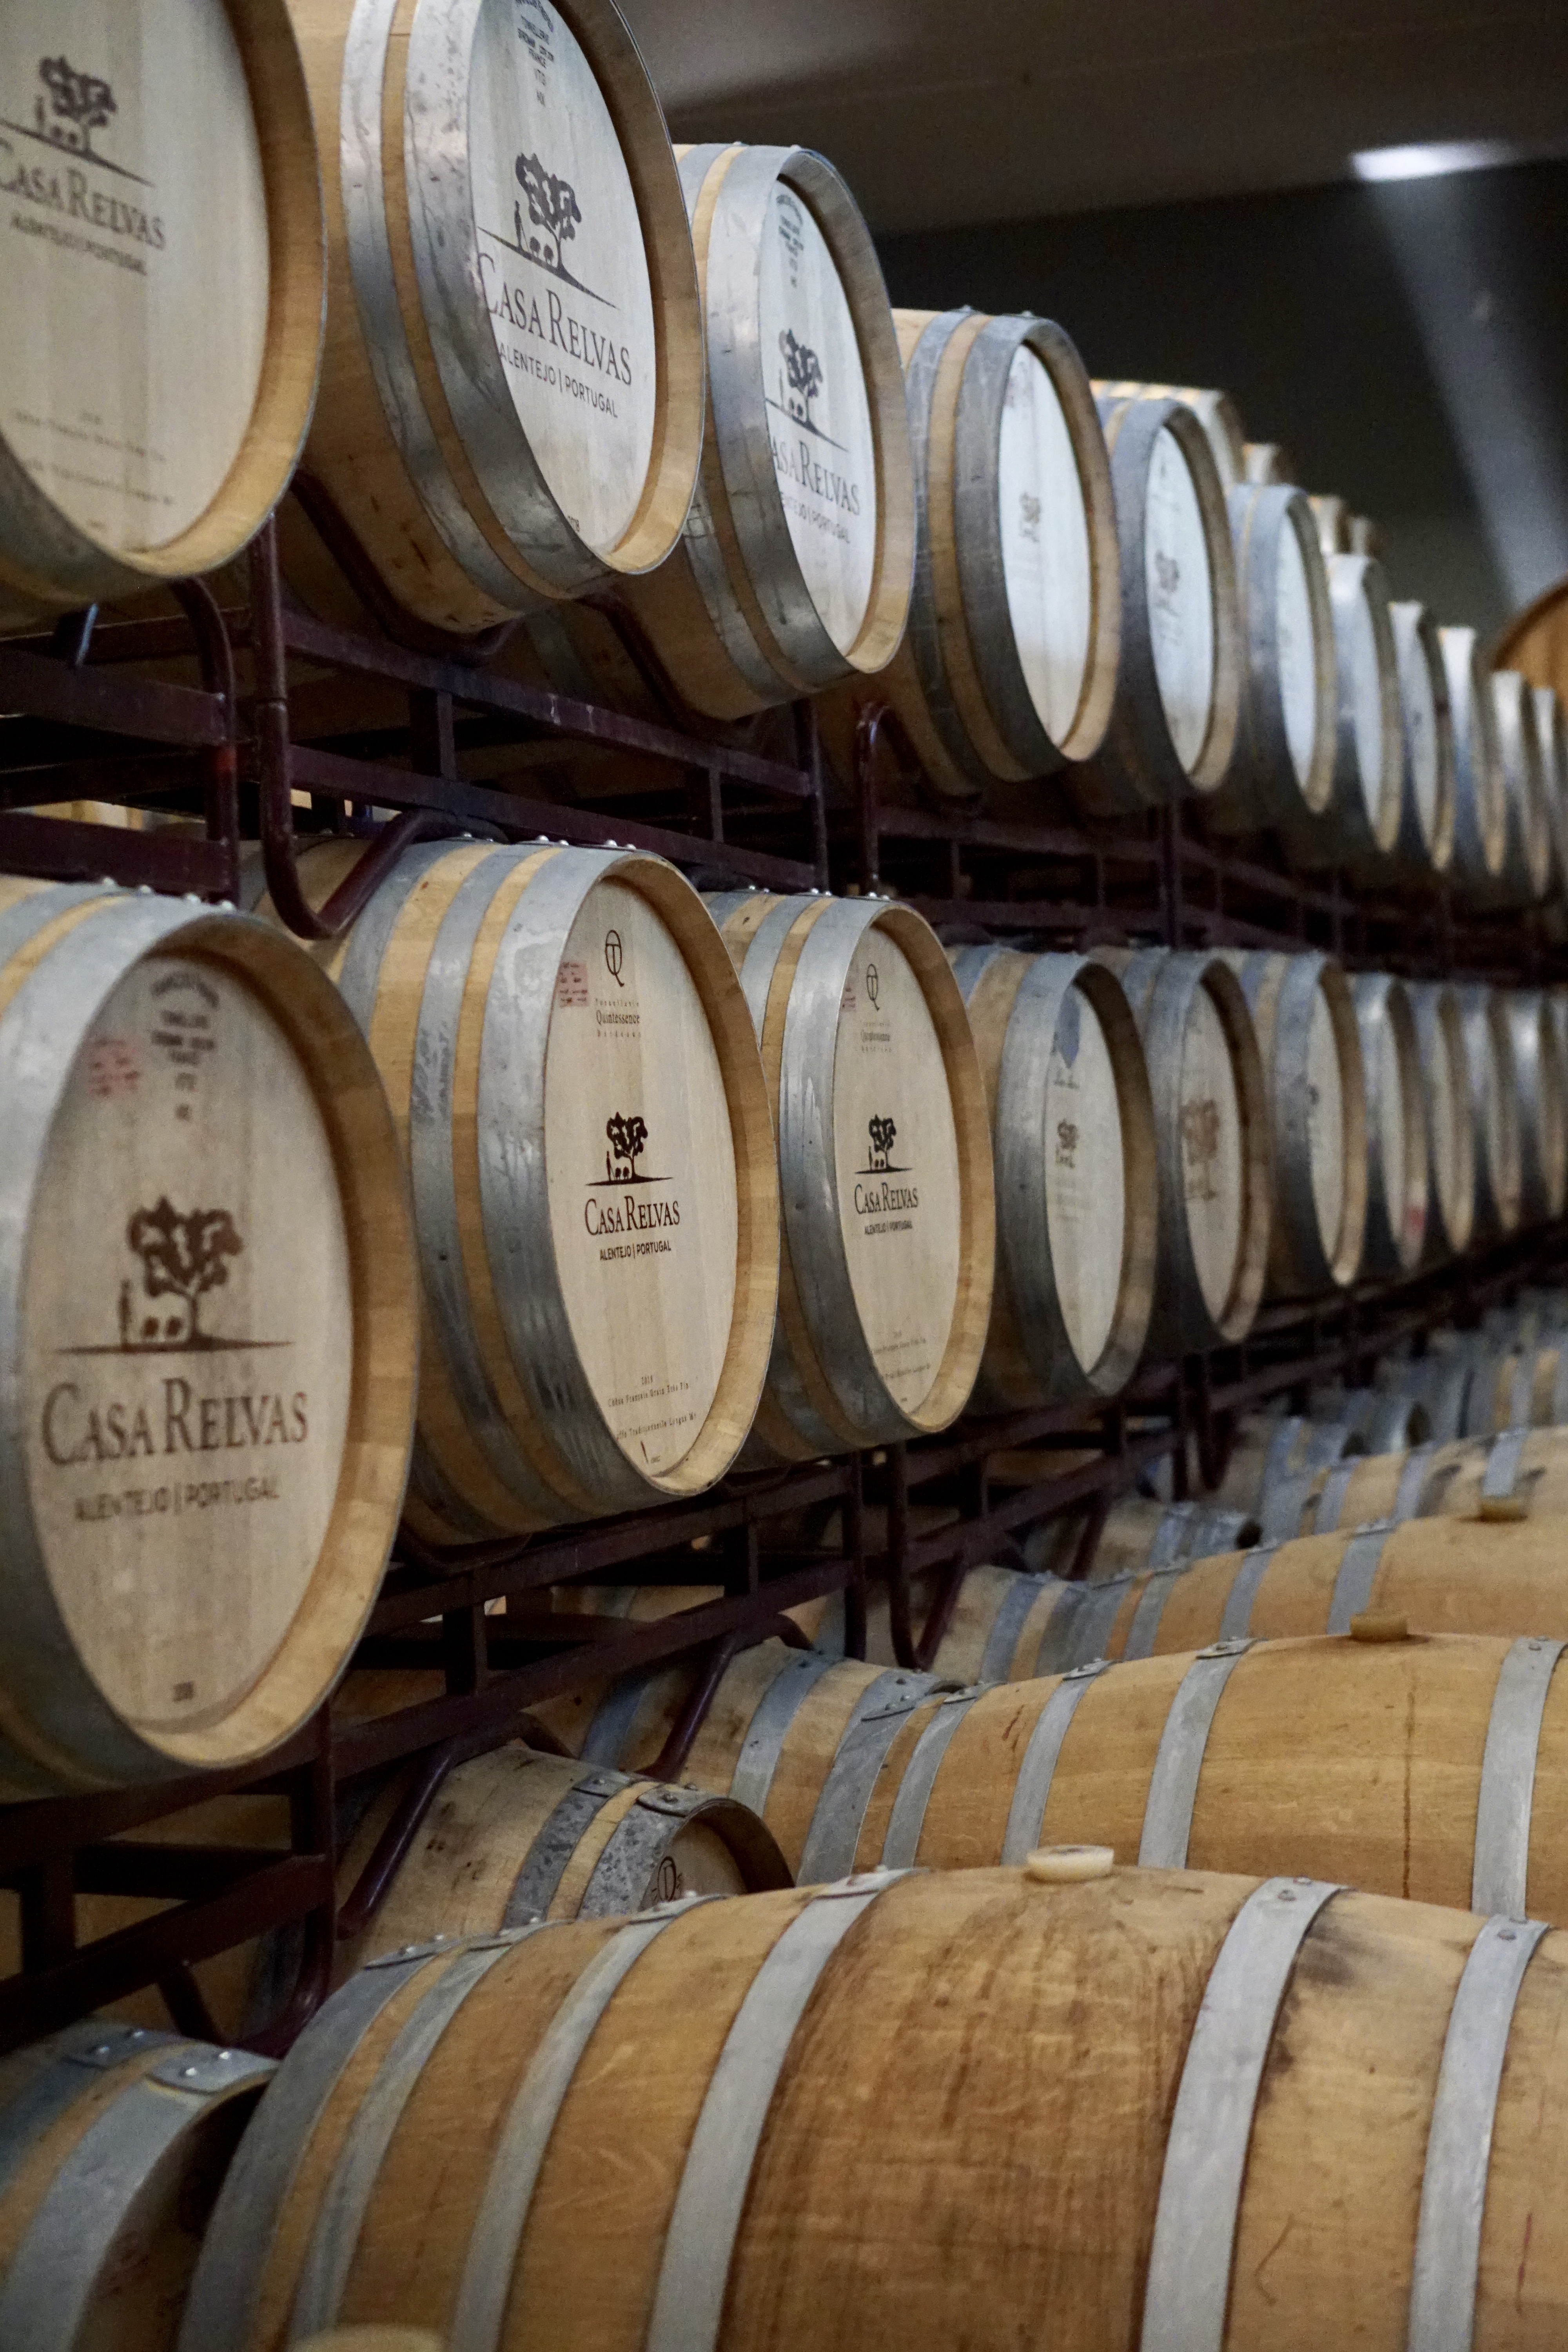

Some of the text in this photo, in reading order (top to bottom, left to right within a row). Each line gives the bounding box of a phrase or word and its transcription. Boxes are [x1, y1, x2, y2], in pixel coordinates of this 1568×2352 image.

[546, 288, 632, 386] RELVAS
[499, 343, 618, 418] ALENTEJO PORTUGAL
[772, 437, 800, 482] ASA
[799, 440, 860, 516] RELVAS
[596, 1010, 640, 1025] Quintessence
[624, 1195, 680, 1230] RELVAS
[881, 1181, 918, 1211] RELVAS
[600, 1240, 671, 1261] ALENTEJO PORTUGAL
[162, 1376, 308, 1455] RELVAS
